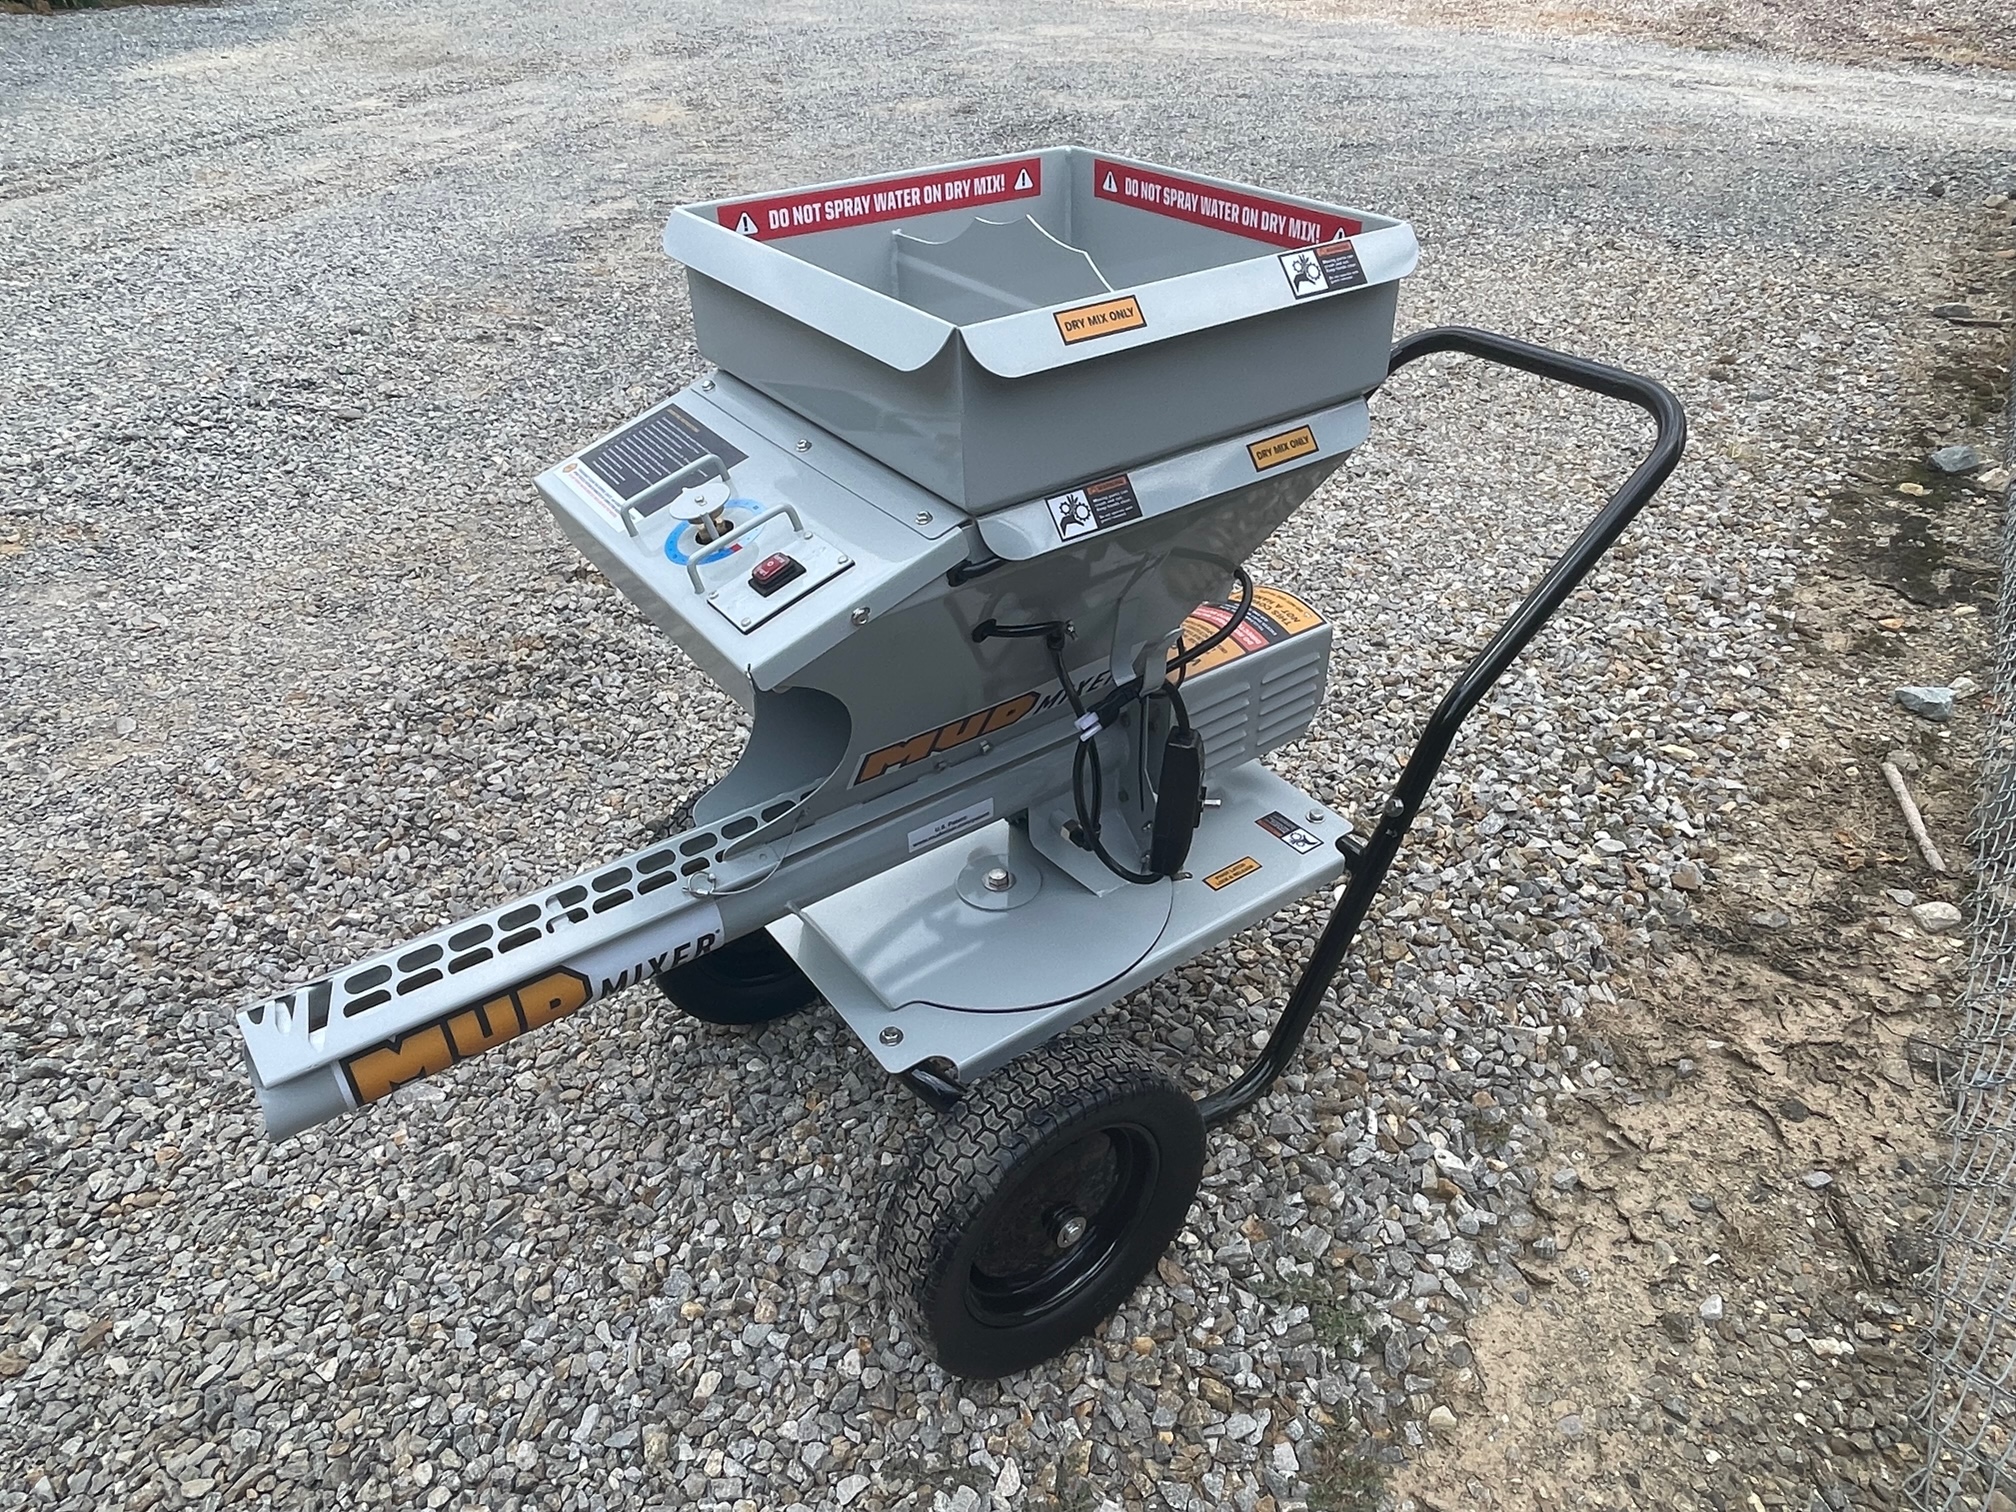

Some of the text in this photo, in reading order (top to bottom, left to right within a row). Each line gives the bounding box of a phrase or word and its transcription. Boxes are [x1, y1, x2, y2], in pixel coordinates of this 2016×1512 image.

[768, 174, 1005, 230] DO NOT SPRAY WATER ON DRY MIX!
[1124, 177, 1321, 244] DO NOT SPRAY WATER ON DRY MIX!
[1064, 306, 1134, 332] DRY MIX ONLY
[1256, 435, 1309, 460] DRY MIX ONLY
[853, 669, 1112, 786] MUD MIXE
[342, 933, 716, 1105] MUD MIXER
